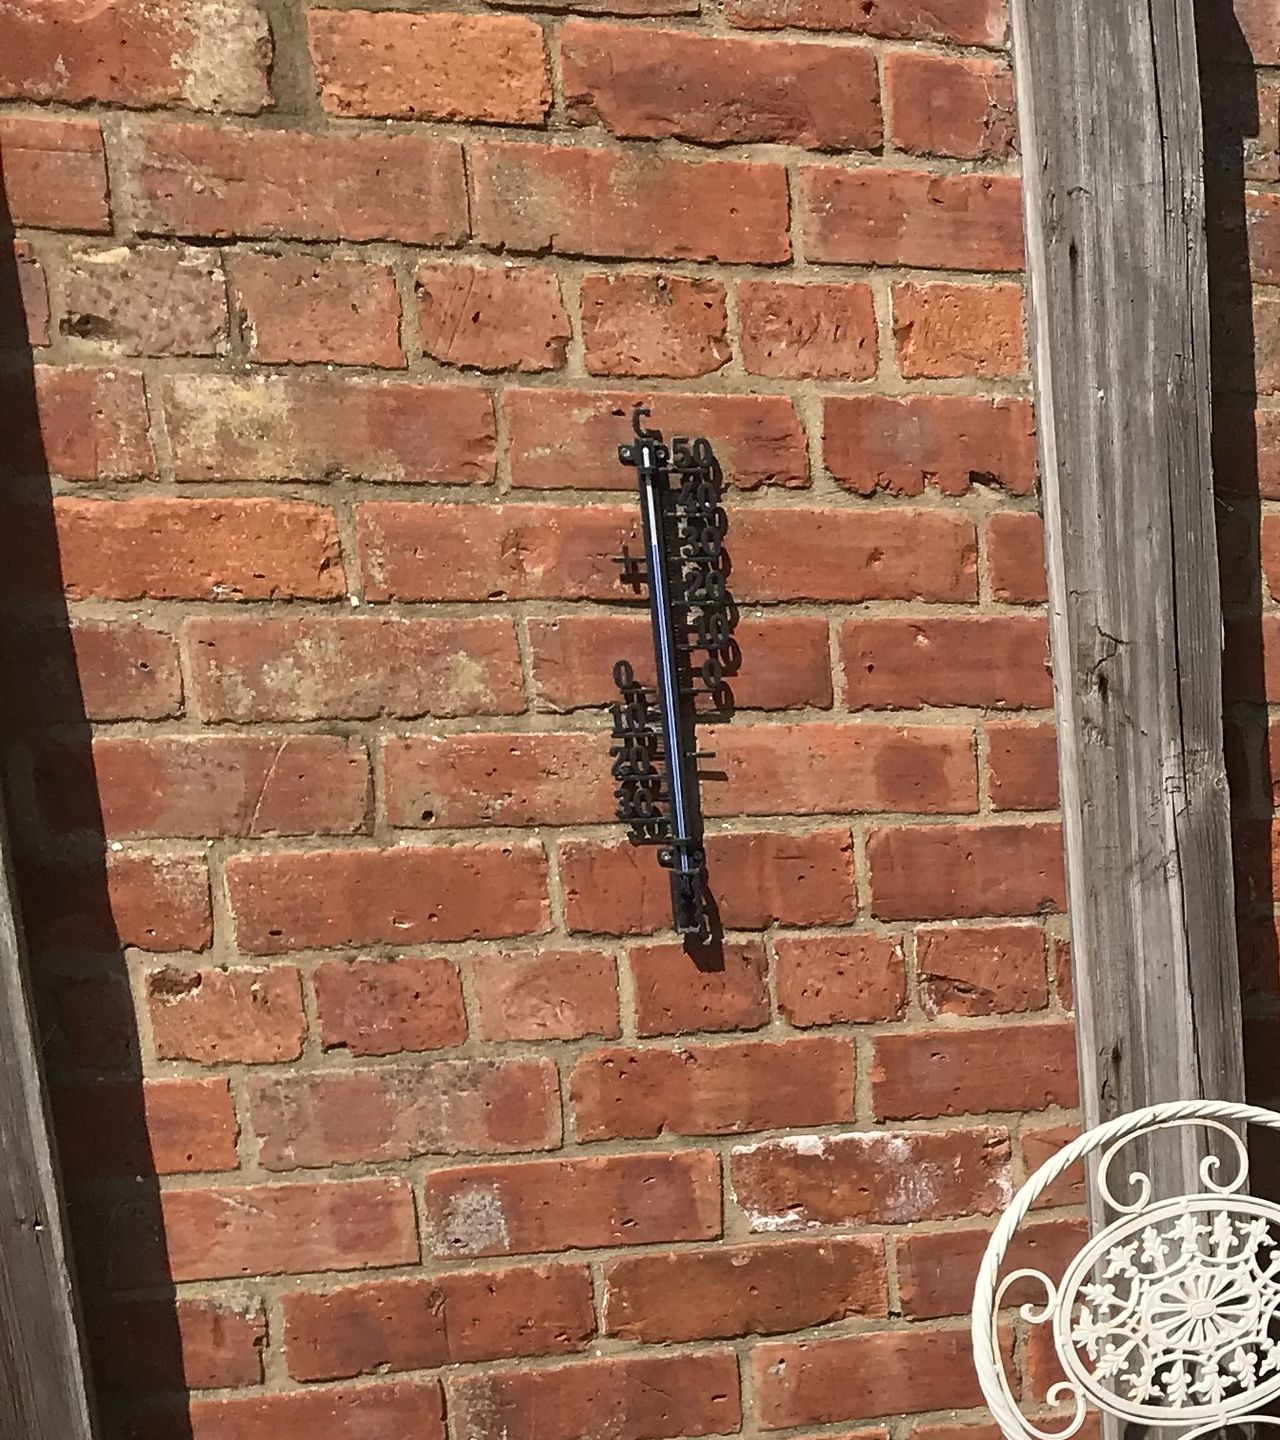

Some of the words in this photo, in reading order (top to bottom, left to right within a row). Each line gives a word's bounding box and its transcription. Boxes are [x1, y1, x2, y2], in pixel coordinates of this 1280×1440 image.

[672, 436, 713, 468] 50
[678, 481, 717, 512] 40
[682, 526, 722, 557] 30
[683, 569, 725, 601] 20
[691, 613, 730, 646] 10
[613, 659, 634, 689] 0
[702, 658, 722, 688] 0
[608, 702, 647, 733] 10
[609, 745, 651, 776] 20
[614, 787, 653, 818] 30
